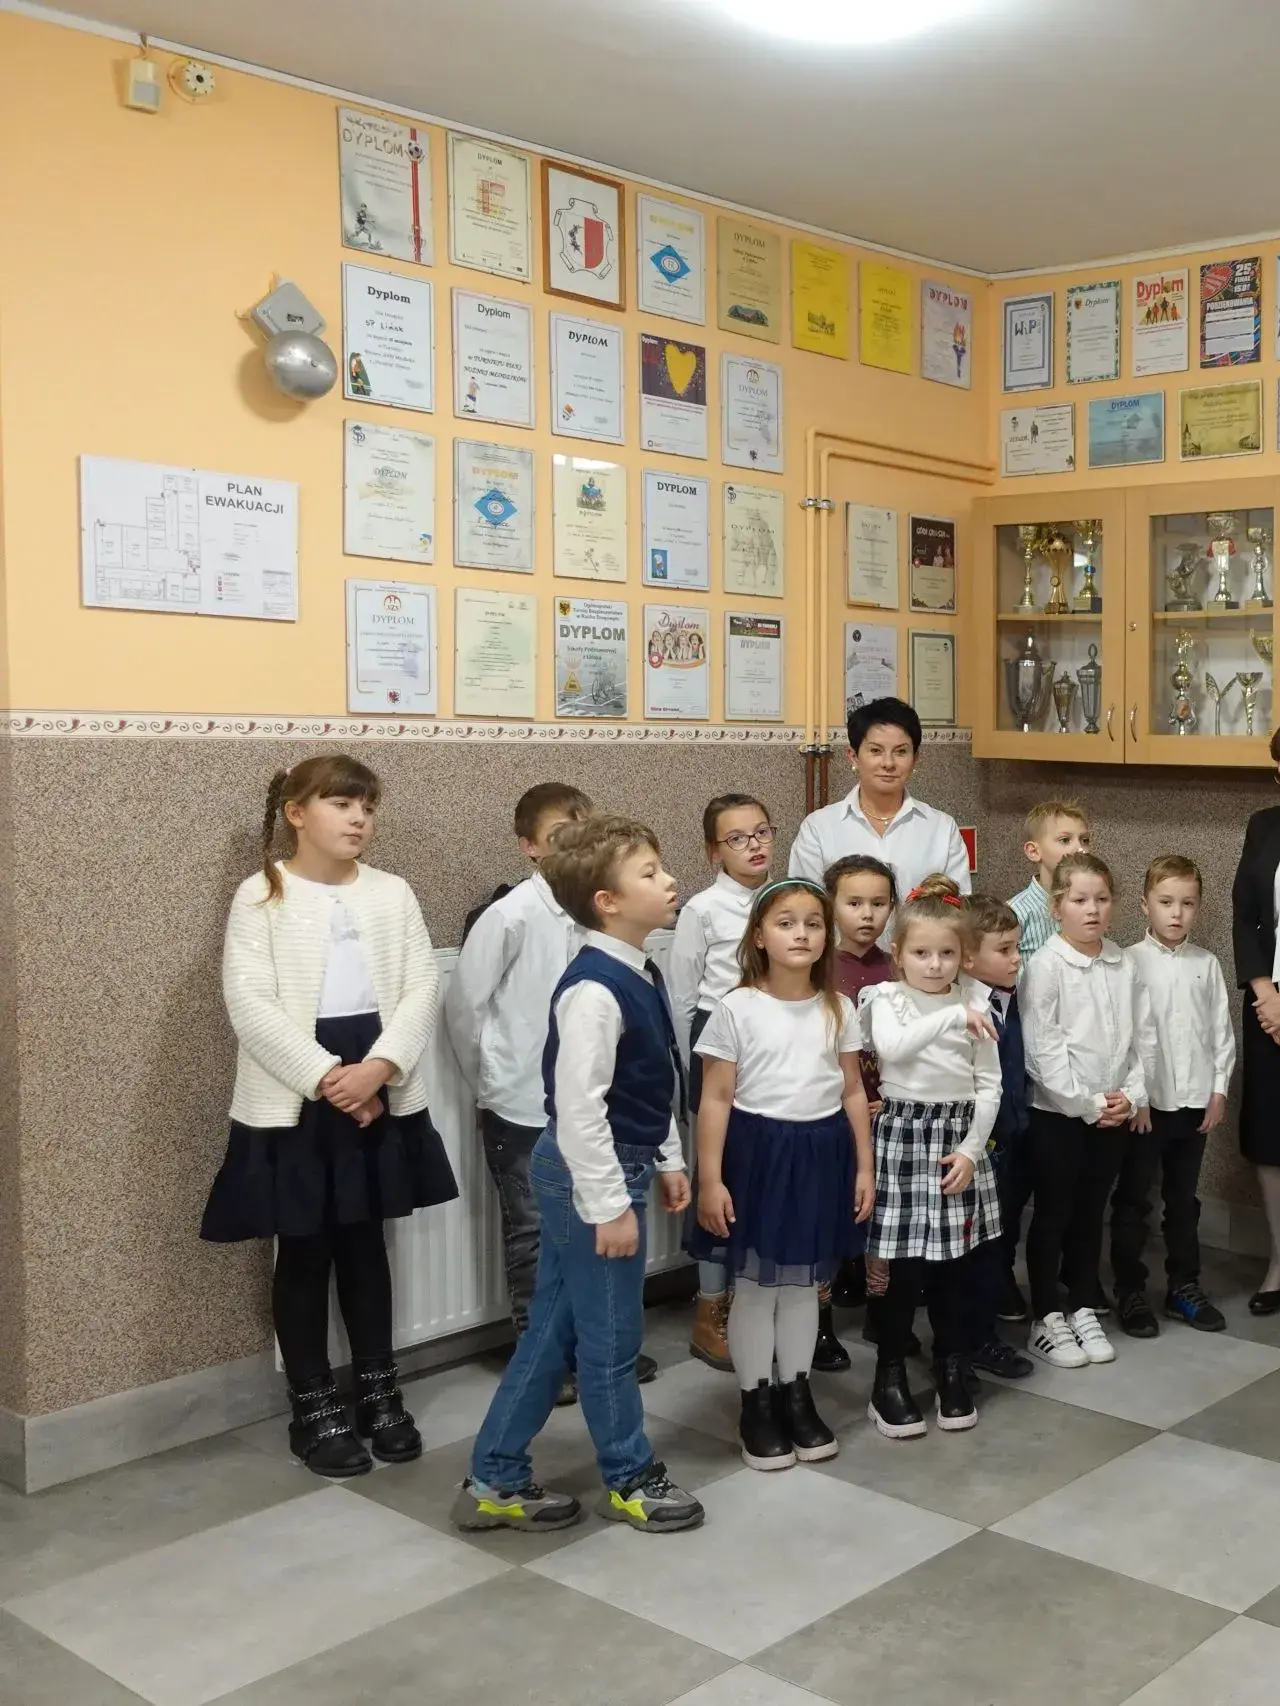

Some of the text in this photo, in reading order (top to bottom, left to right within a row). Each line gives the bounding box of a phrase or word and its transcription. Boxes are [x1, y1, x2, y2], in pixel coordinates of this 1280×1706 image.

[342, 128, 404, 158] DYPLOM
[477, 153, 504, 168] DYPLOM
[733, 232, 766, 249] DYPLOM
[1235, 262, 1253, 277] 25
[367, 286, 412, 306] Dyplom
[1136, 277, 1184, 301] Dyplom
[1085, 297, 1110, 308] Dyplom
[477, 303, 512, 321] Dyplom
[568, 330, 609, 348] DYPLOM
[641, 336, 659, 346] Dyplom
[738, 384, 768, 397] DYPLOM
[1110, 399, 1141, 411] DYPLOM
[227, 482, 263, 497] PLAN
[656, 482, 698, 497] DYPLOM
[205, 495, 285, 516] EWAKUACJI
[372, 613, 416, 626] DYPLOM
[658, 611, 700, 632] Dyplom
[559, 624, 626, 642] DYPLOM
